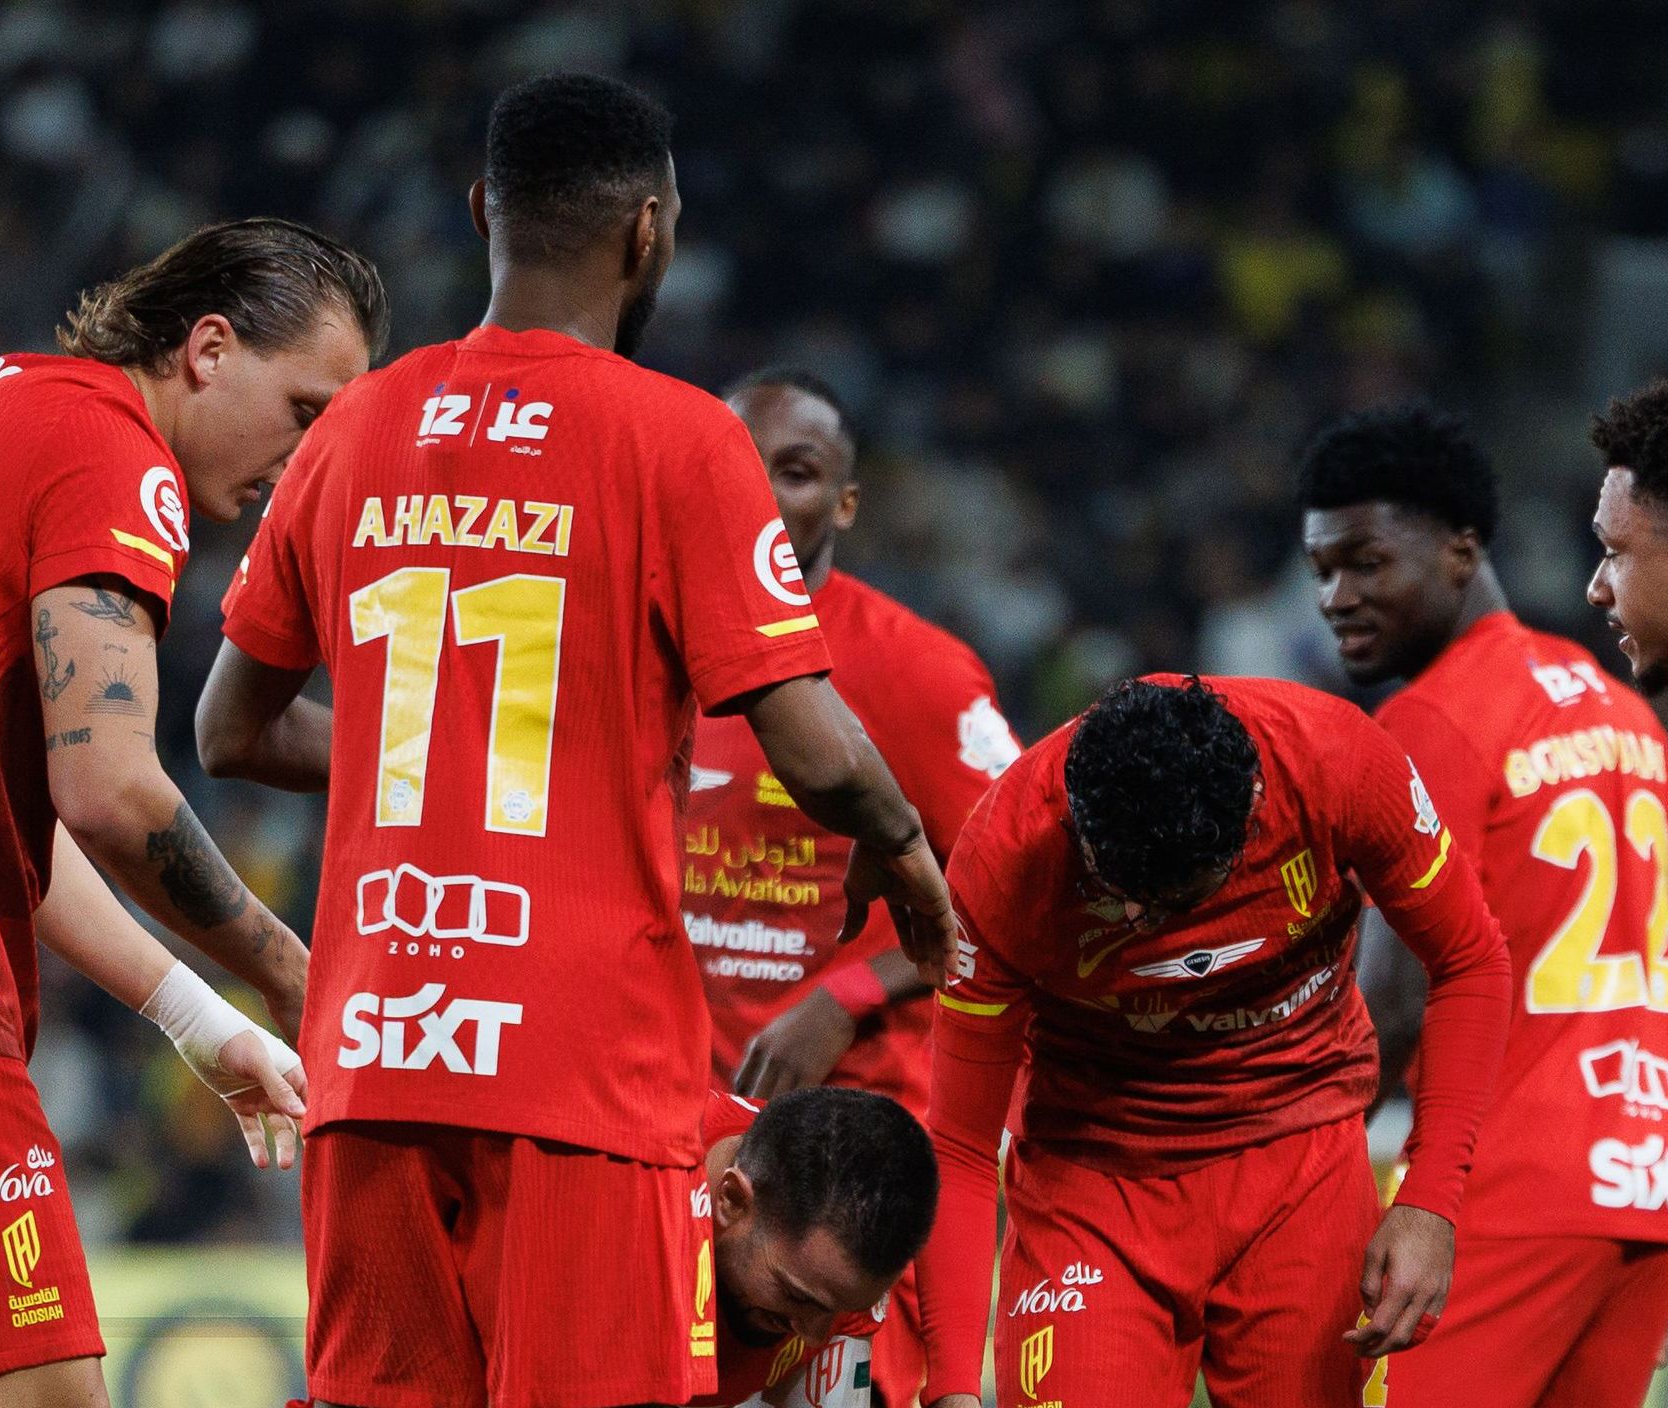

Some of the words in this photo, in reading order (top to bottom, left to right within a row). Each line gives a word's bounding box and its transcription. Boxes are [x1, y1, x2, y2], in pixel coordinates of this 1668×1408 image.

[352, 494, 574, 557] A.HAZAZI
[349, 567, 566, 837] 11
[710, 866, 821, 906] Aviation
[388, 941, 464, 959] ZOHO
[9, 1286, 61, 1311] القادسية
[11, 1305, 65, 1328] QADSIAH
